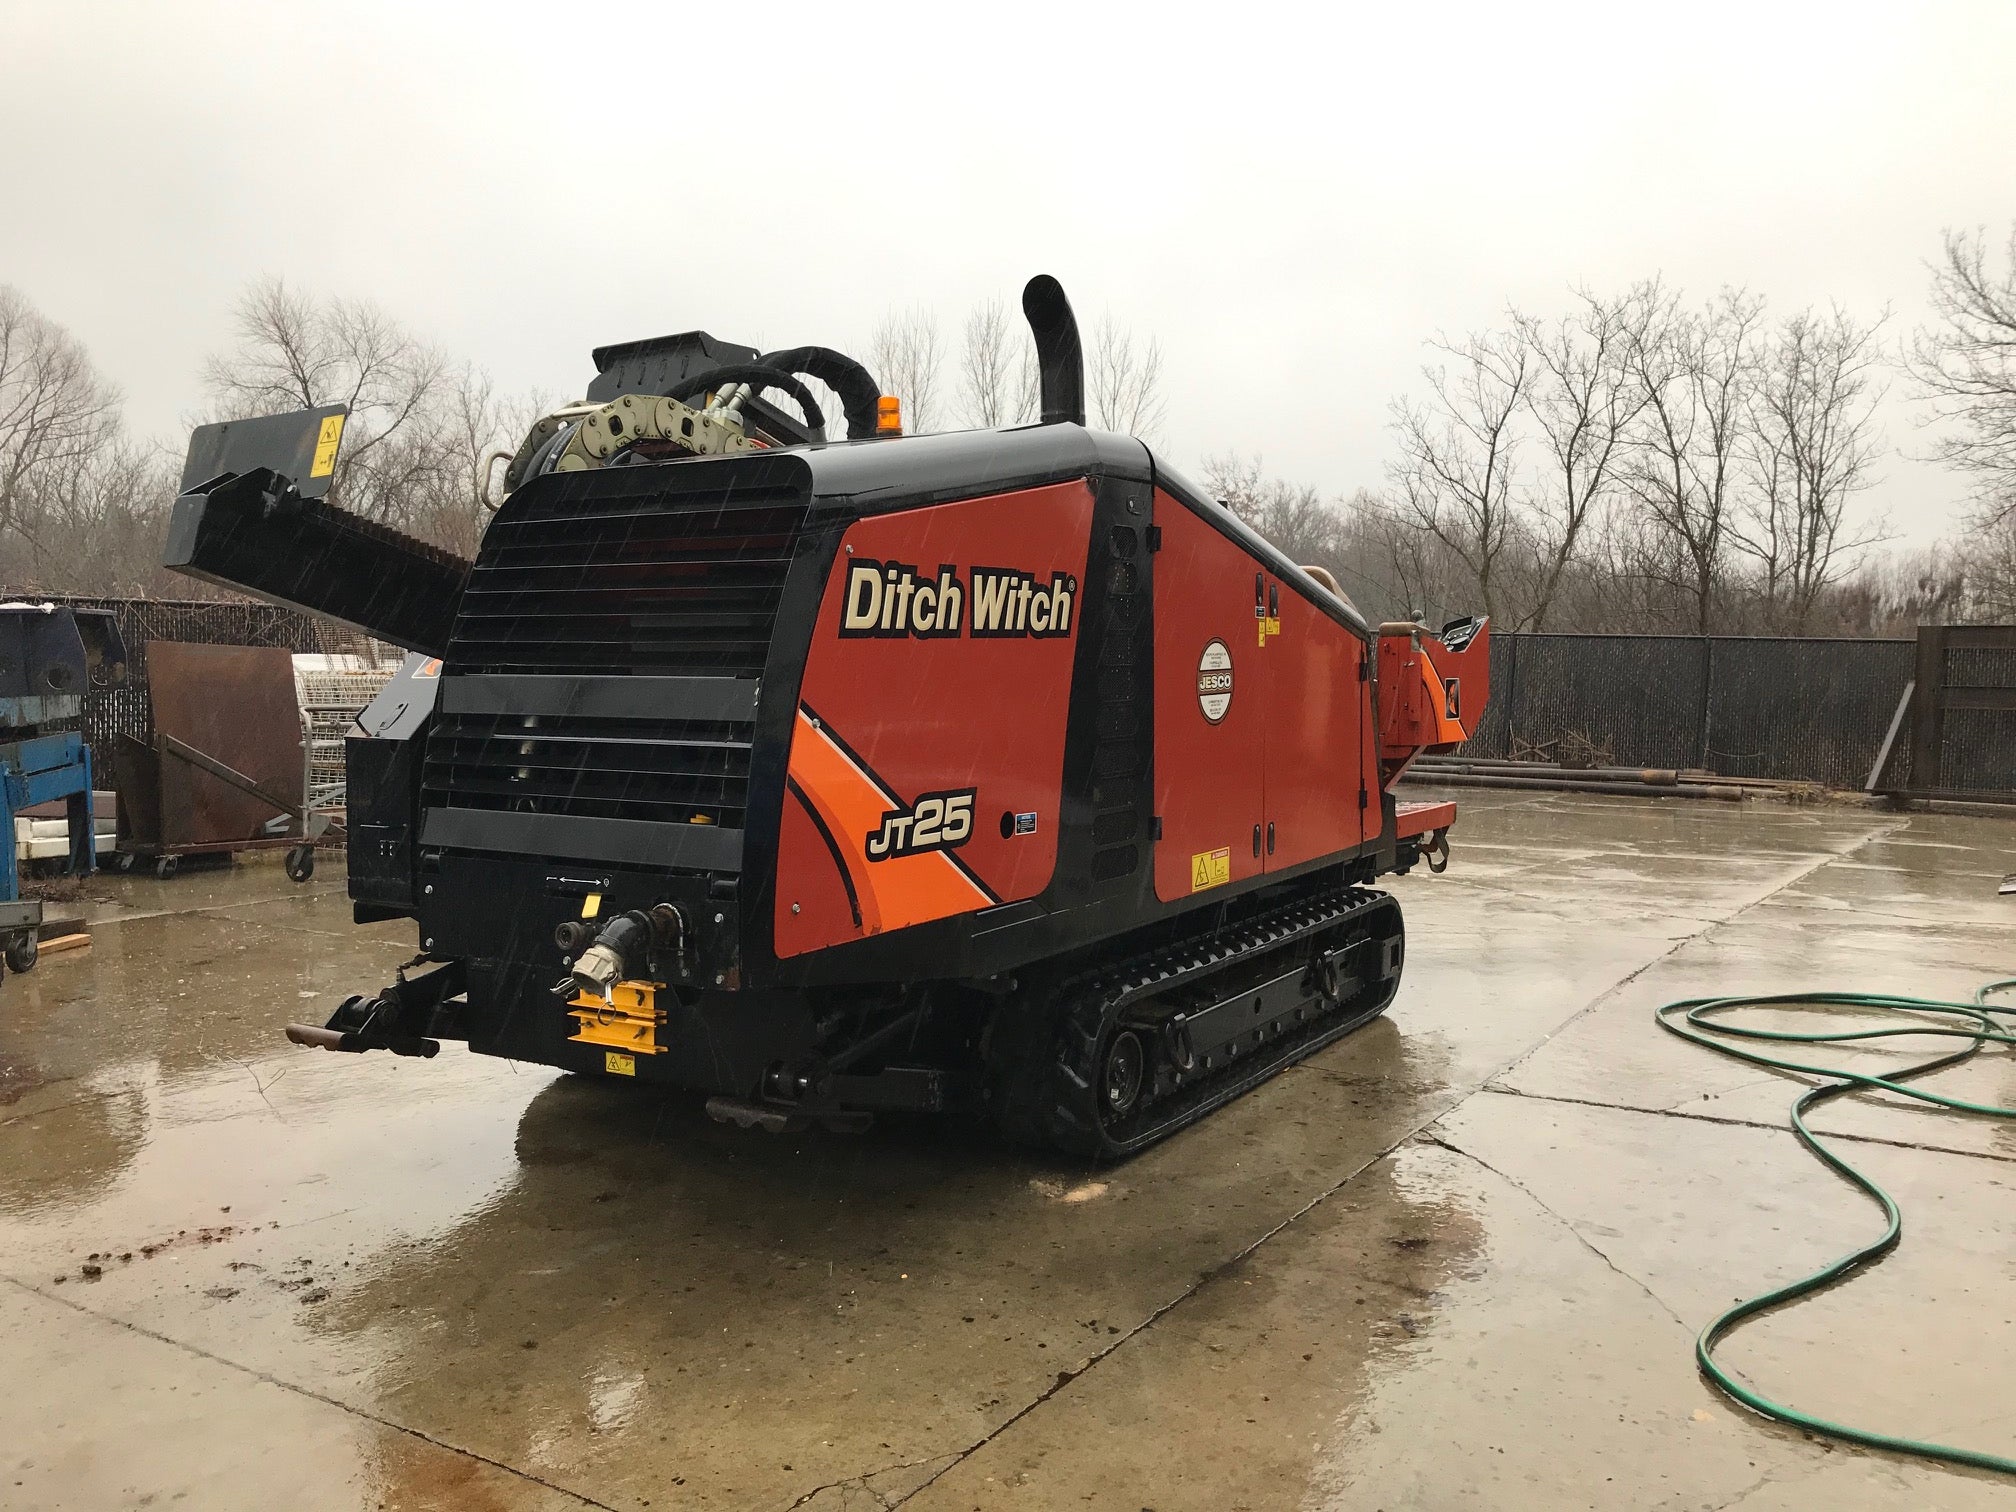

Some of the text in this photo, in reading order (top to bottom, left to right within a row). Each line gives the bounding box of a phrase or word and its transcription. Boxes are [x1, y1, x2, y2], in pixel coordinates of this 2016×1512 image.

[845, 567, 962, 631] Ditch
[1200, 675, 1231, 690] JESCO
[869, 795, 973, 854] JT25
